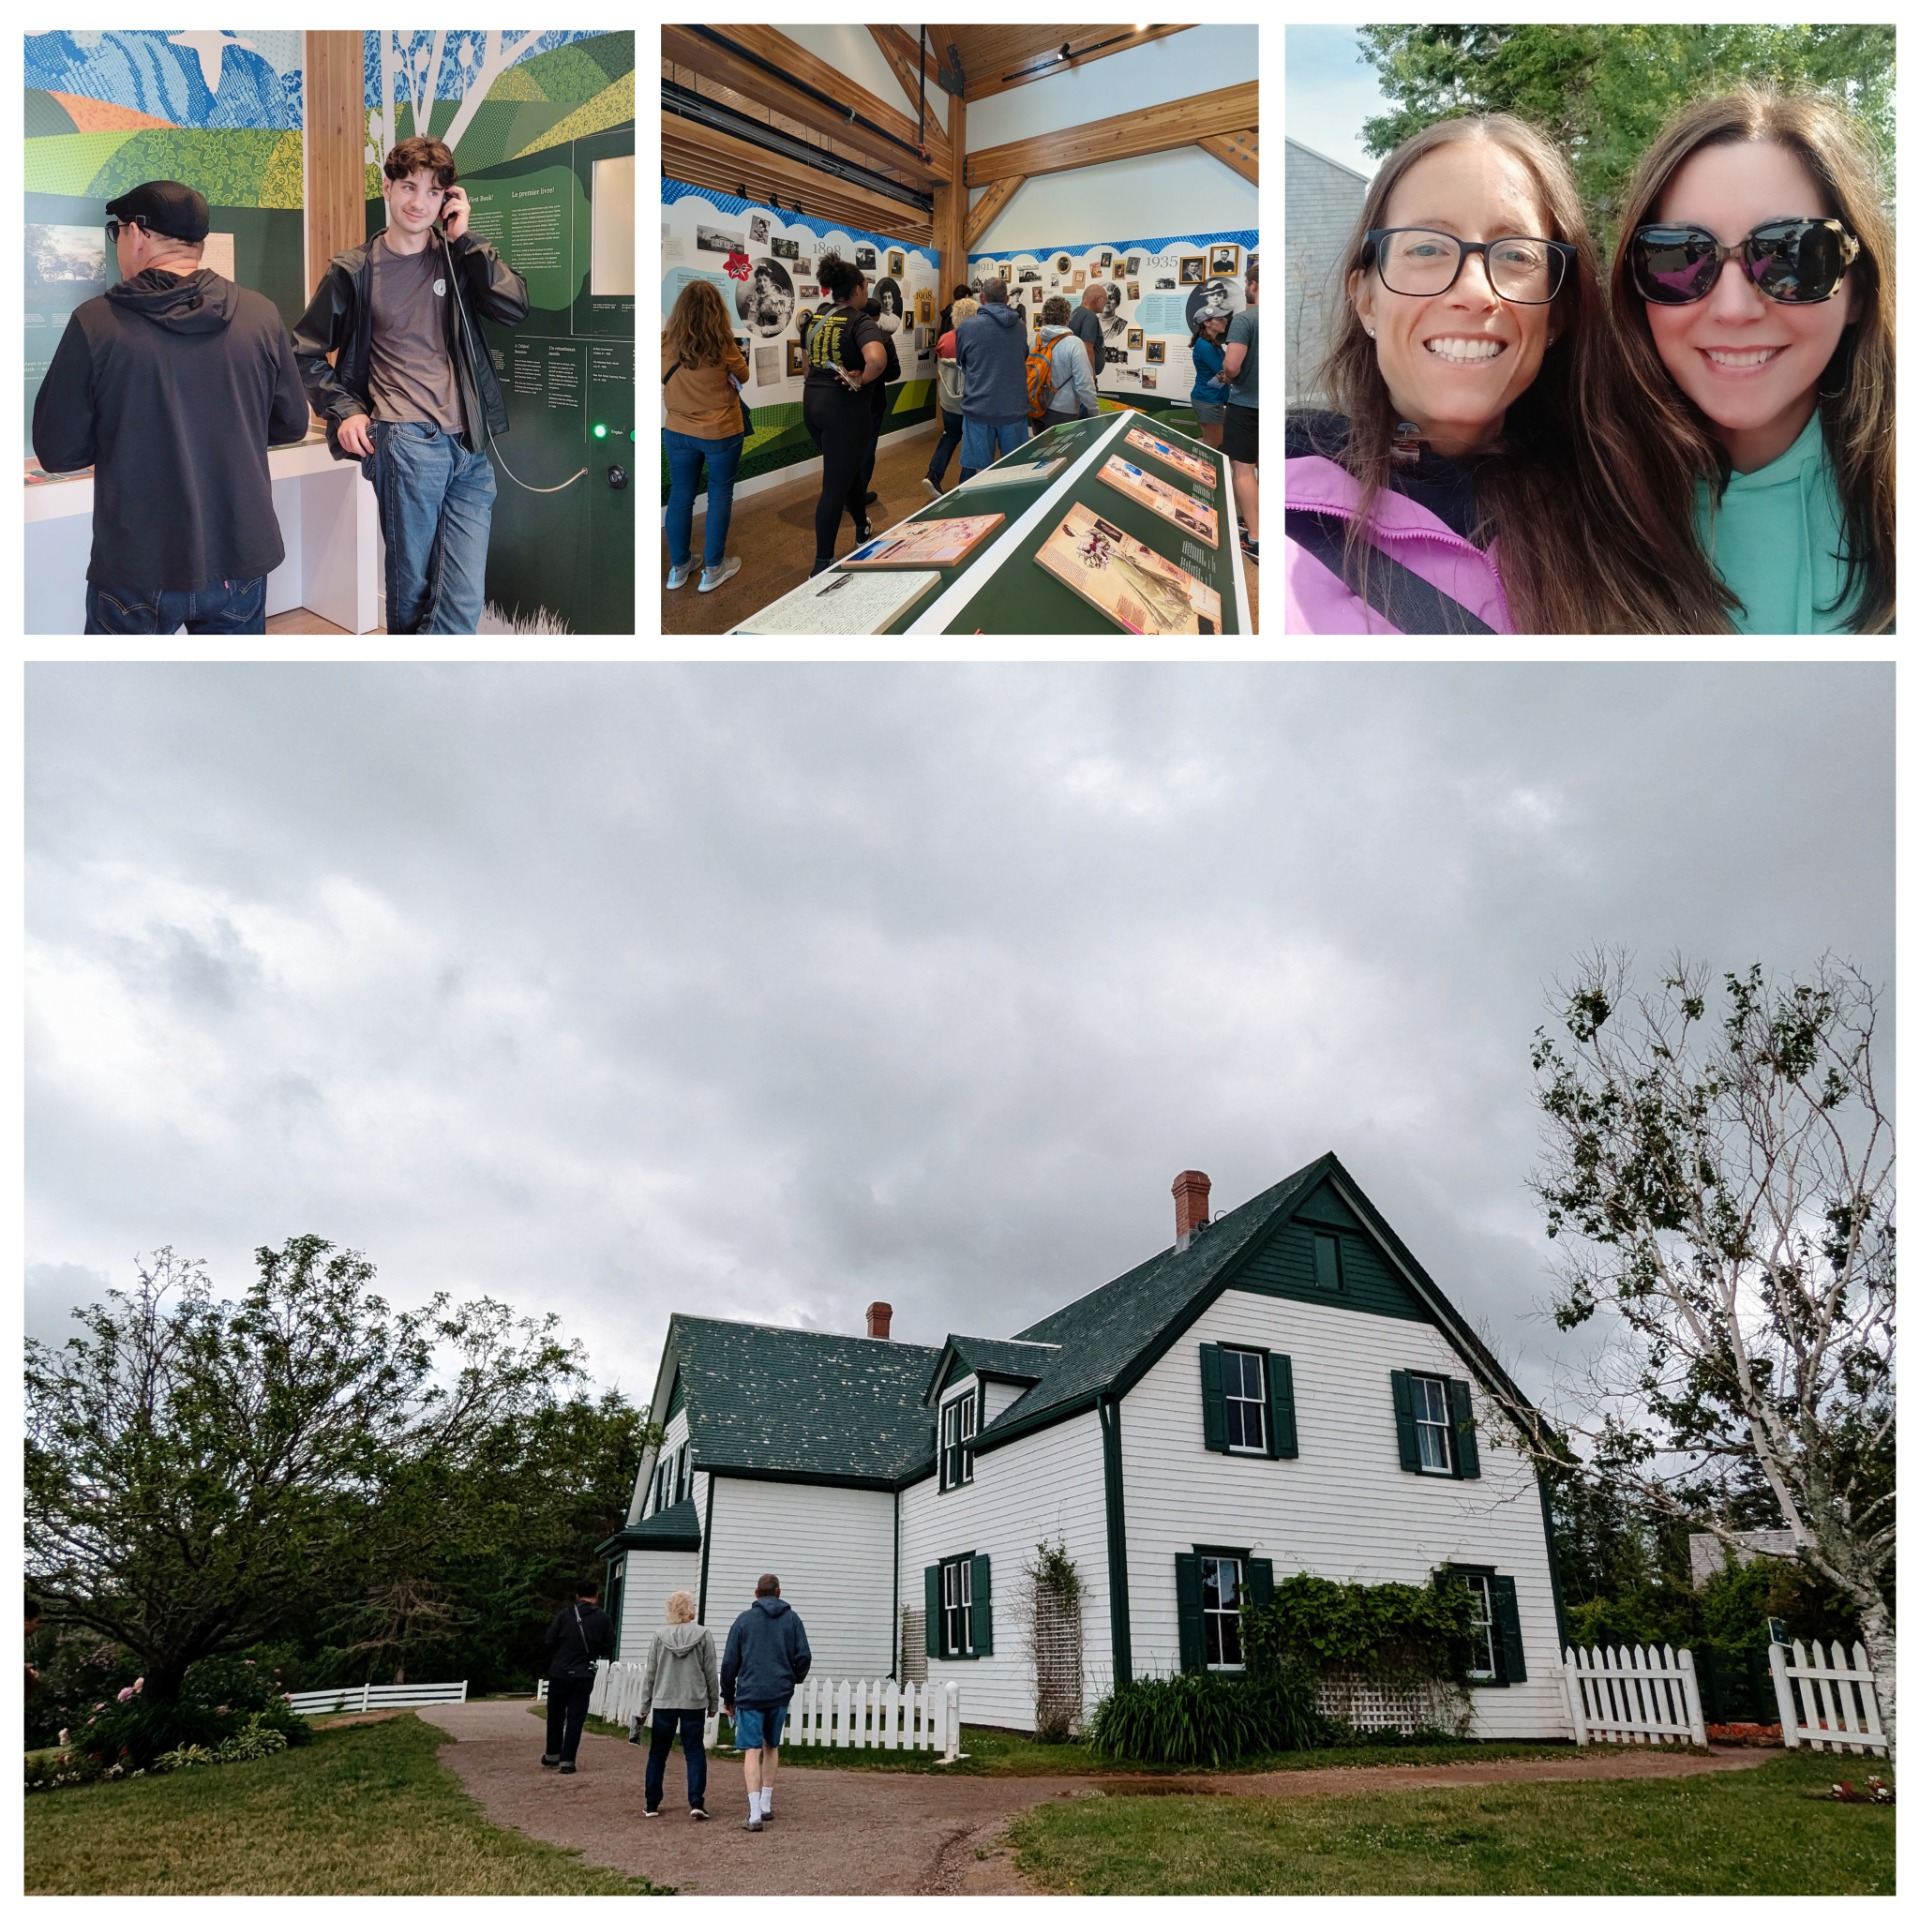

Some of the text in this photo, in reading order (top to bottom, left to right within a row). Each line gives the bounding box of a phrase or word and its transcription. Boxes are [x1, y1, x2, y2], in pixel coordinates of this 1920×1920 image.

[480, 194, 494, 202] Book!
[518, 189, 539, 198] premier
[540, 186, 555, 195] livre!
[976, 262, 994, 272] 1911
[1145, 255, 1179, 268] 1935
[915, 290, 933, 302] 1908
